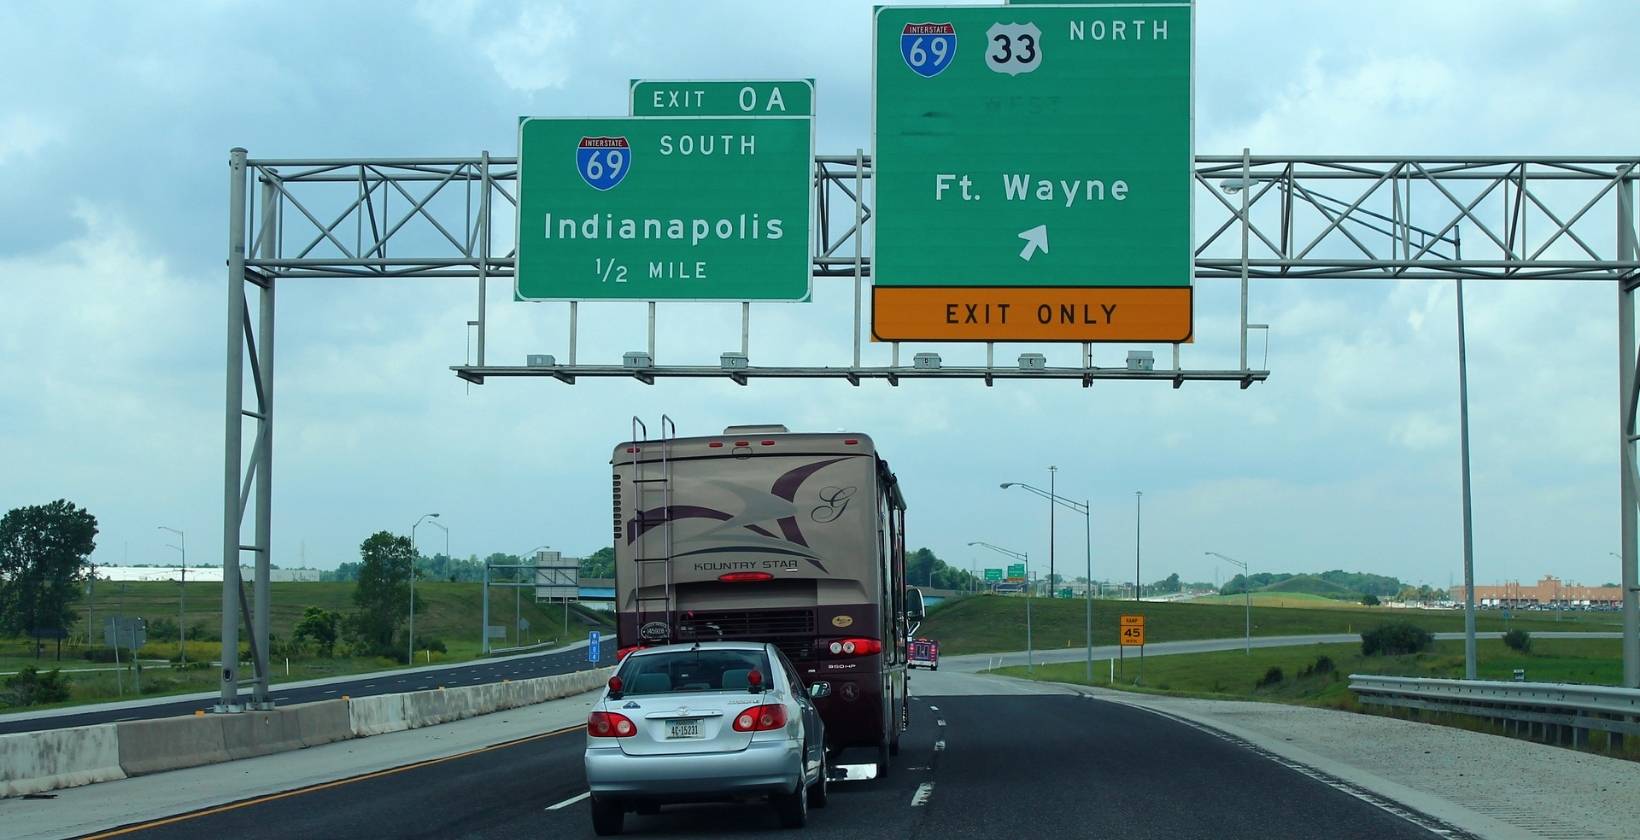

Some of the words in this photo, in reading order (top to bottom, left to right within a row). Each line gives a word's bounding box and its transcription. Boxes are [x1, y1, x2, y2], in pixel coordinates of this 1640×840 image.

[909, 25, 948, 34] INTERSTATE
[1069, 20, 1169, 41] NORTH
[909, 37, 948, 67] 69
[991, 34, 1037, 64] 33
[653, 90, 705, 108] EXIT
[585, 138, 624, 147] INTERSTATE
[659, 135, 755, 155] SOUTH
[586, 150, 624, 180] 69
[935, 174, 981, 201] Ft.
[1003, 173, 1130, 208] Wayne
[544, 213, 784, 246] Indianapolis
[649, 261, 707, 279] MILE
[945, 303, 1011, 324] EXIT
[1036, 303, 1118, 325] ONLY
[694, 562, 756, 571] KOUNTRY
[762, 560, 798, 568] STAR
[1124, 628, 1141, 637] 45
